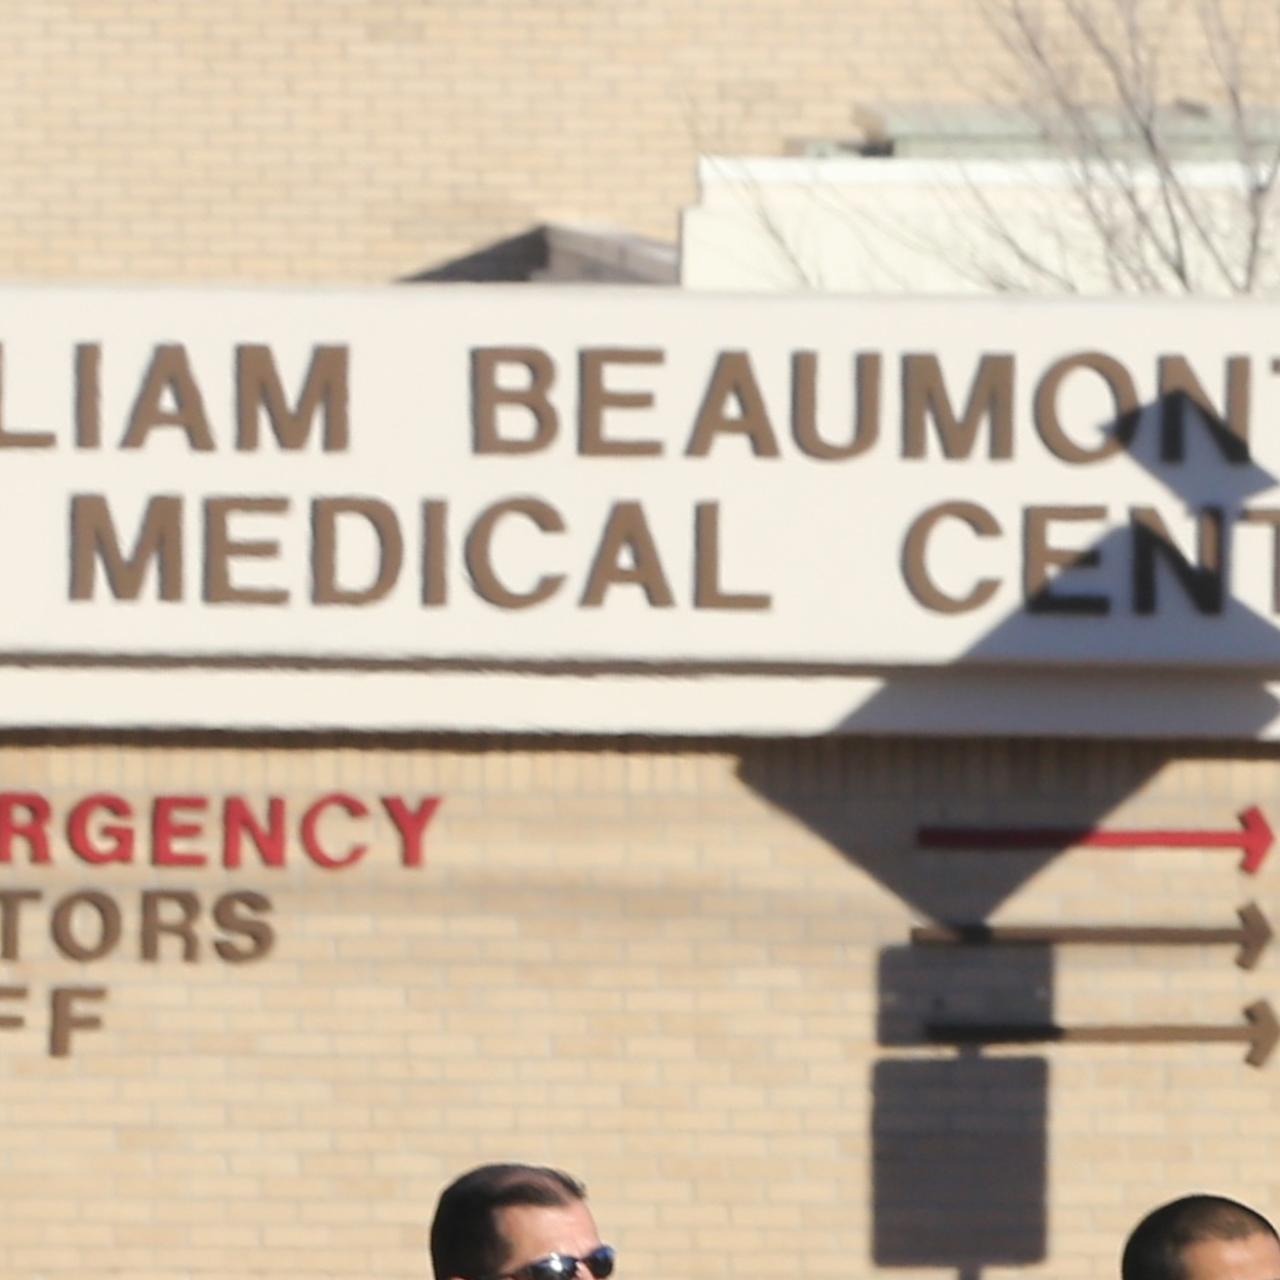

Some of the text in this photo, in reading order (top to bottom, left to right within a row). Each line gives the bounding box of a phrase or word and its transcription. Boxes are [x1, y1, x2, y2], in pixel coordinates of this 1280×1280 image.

[67, 494, 773, 611] MEDICAL
[0, 791, 442, 869] RGENCY
[0, 889, 275, 965] TORS
